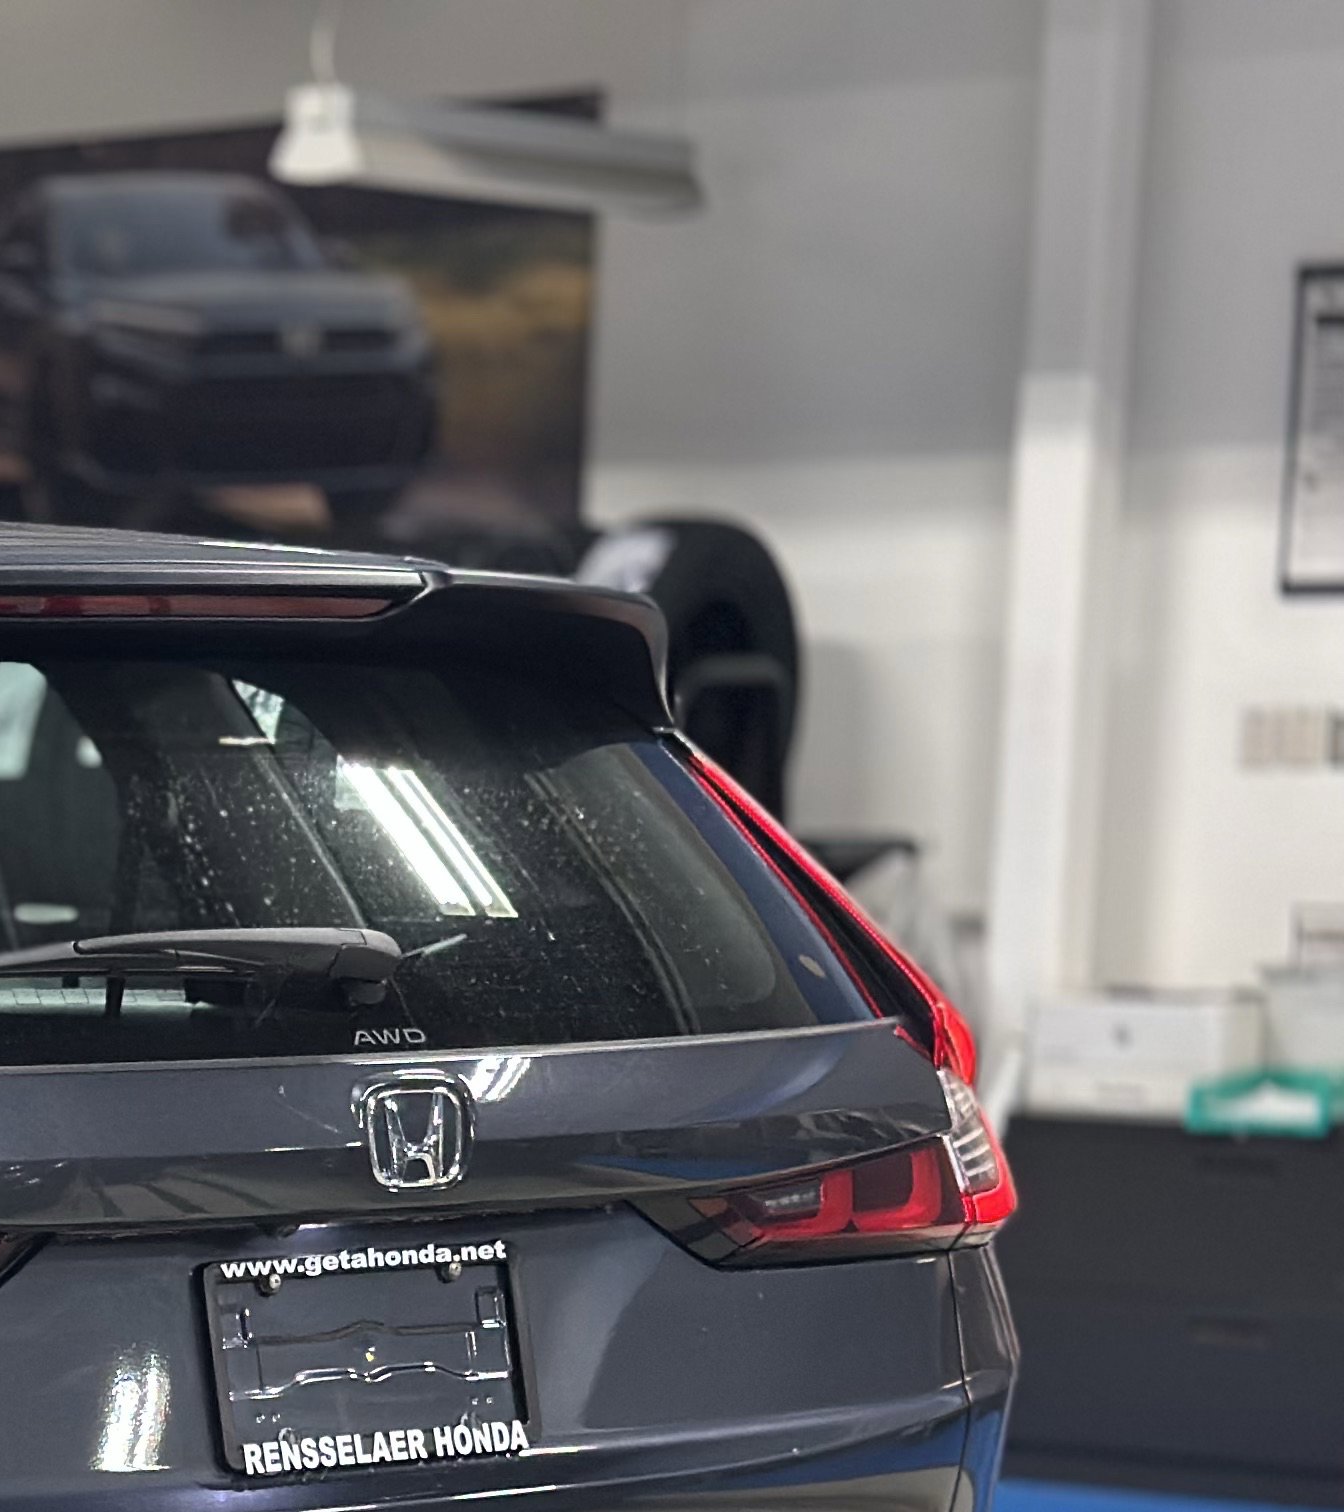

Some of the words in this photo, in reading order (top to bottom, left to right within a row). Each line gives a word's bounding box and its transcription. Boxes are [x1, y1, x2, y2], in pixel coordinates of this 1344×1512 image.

[353, 1027, 427, 1046] AWD
[220, 1239, 507, 1278] www.getahonda.net
[243, 1429, 428, 1475] RENSSELAER
[433, 1420, 530, 1459] HONDA
